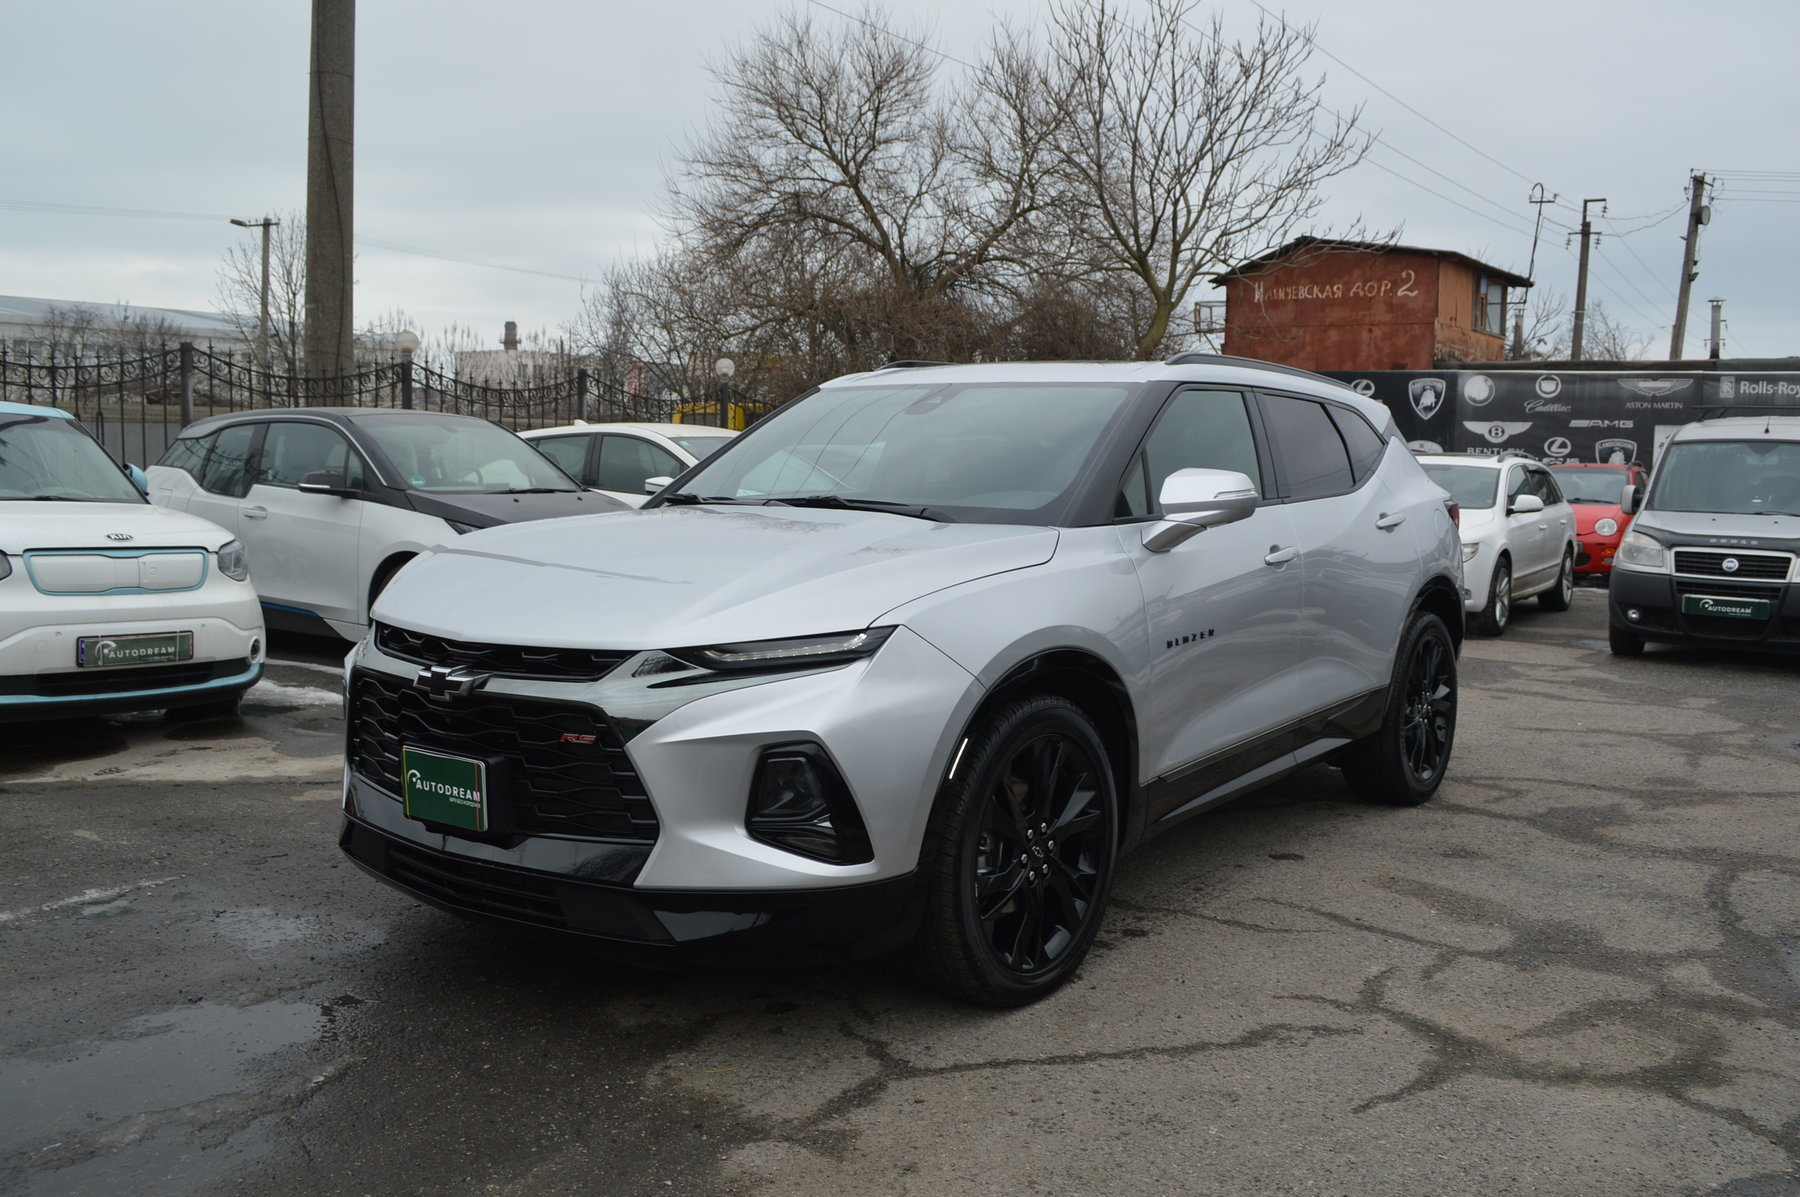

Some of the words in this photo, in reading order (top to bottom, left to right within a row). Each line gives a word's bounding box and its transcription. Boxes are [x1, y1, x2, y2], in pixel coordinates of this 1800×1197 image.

[1397, 269, 1419, 297] 2
[1589, 420, 1634, 428] AMG
[109, 646, 175, 658] AUTODREAM
[561, 733, 597, 744] RS
[415, 779, 481, 802] AUTODREAM
